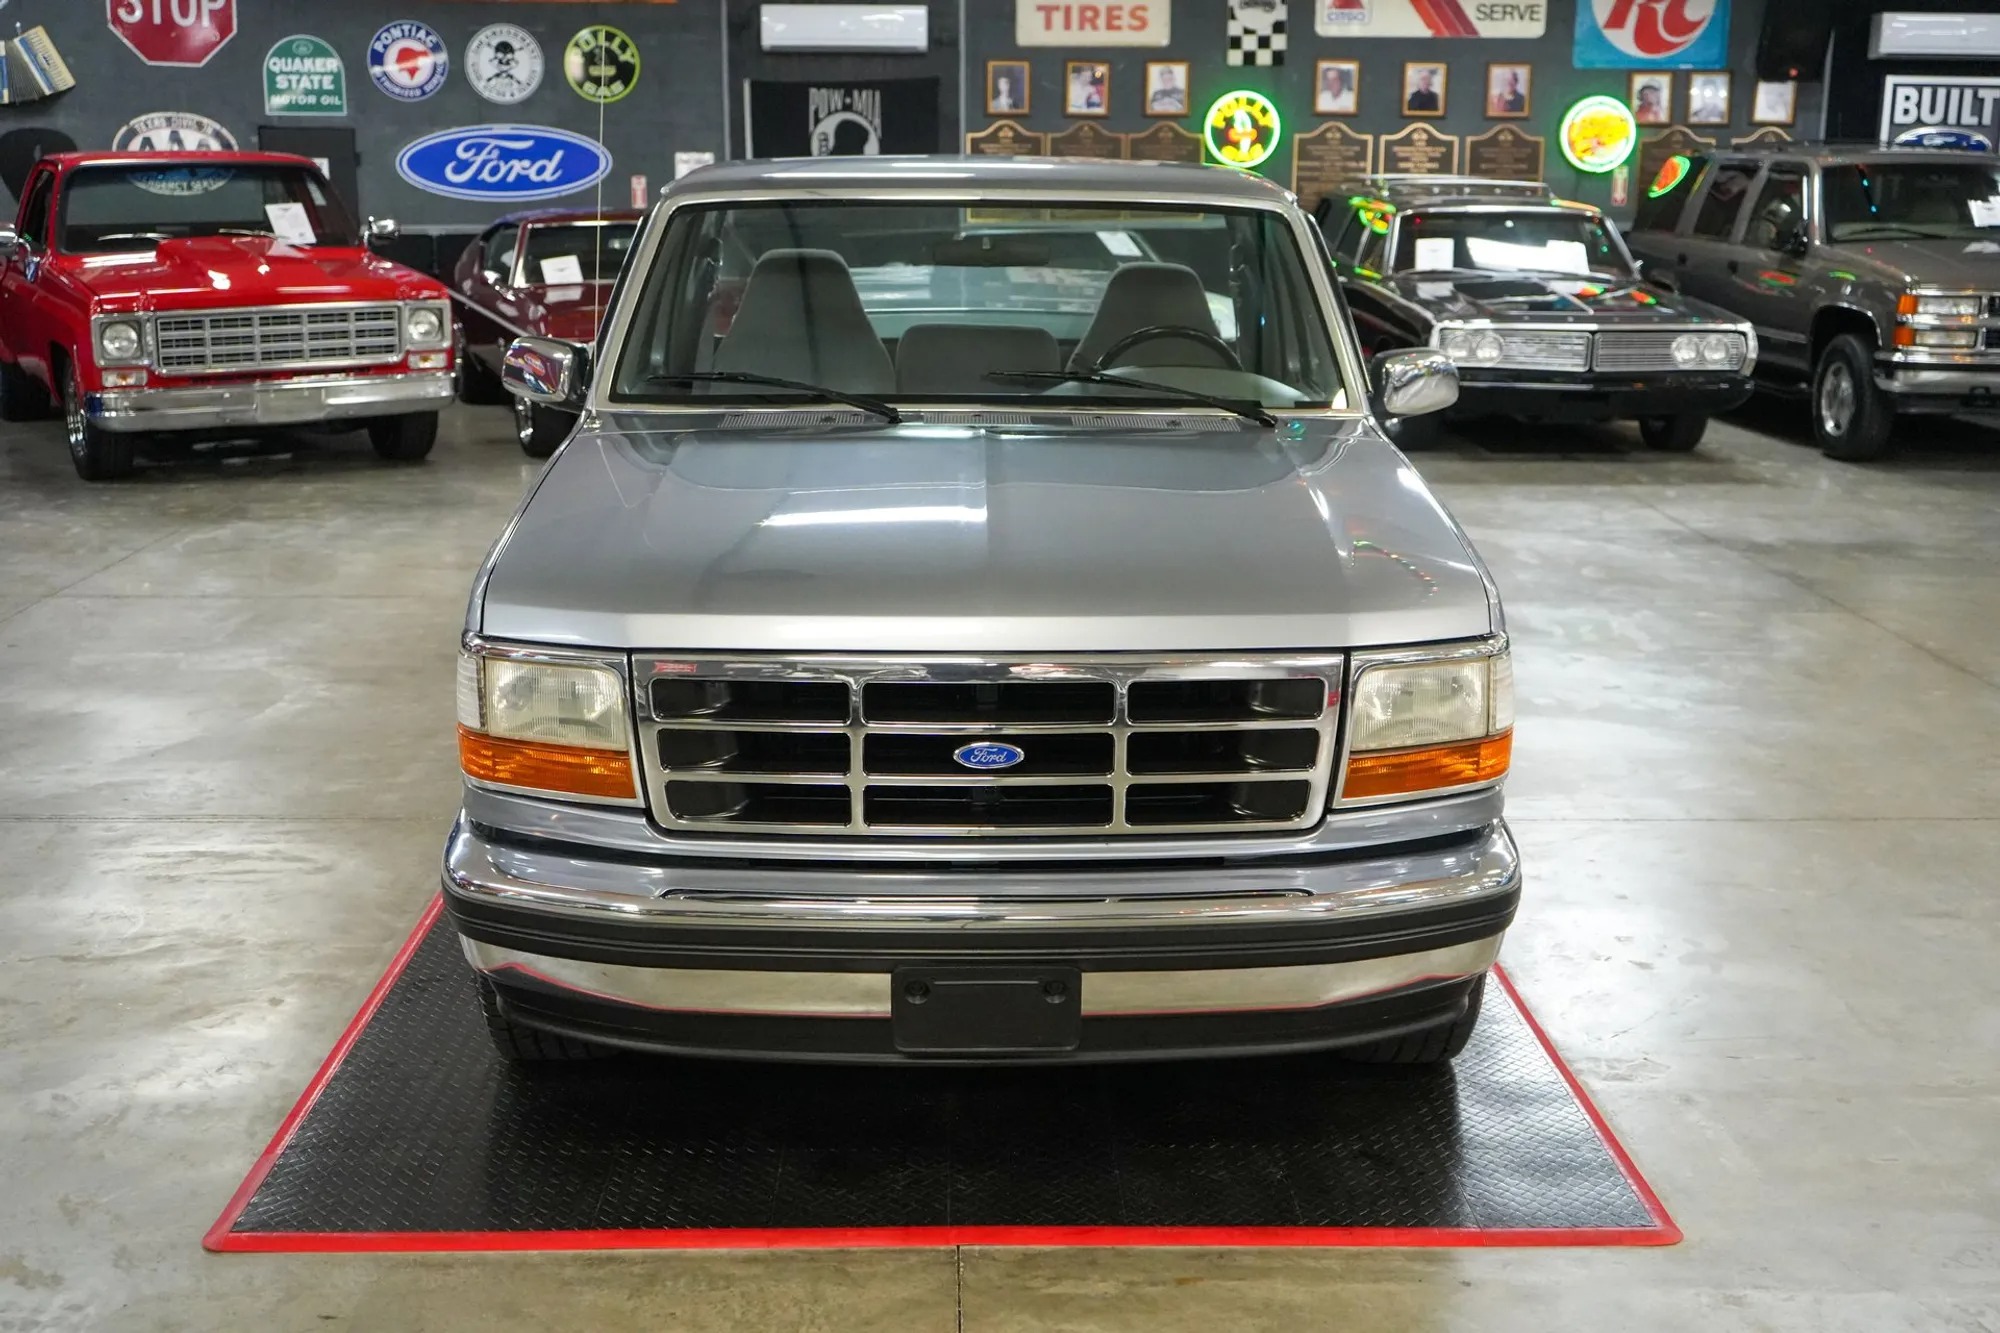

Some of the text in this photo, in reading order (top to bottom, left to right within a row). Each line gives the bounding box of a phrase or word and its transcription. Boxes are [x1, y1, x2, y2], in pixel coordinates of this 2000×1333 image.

[1036, 4, 1149, 32] TIRES
[1327, 11, 1366, 22] CITGO
[1475, 3, 1542, 22] SERVE
[373, 24, 437, 53] PONTIAC
[268, 56, 339, 74] QUAKER
[275, 73, 336, 90] STATE
[269, 94, 343, 106] MOTOR OIL
[1893, 85, 2000, 126] BUILT
[443, 137, 564, 184] Ford
[970, 747, 1008, 763] Ford
